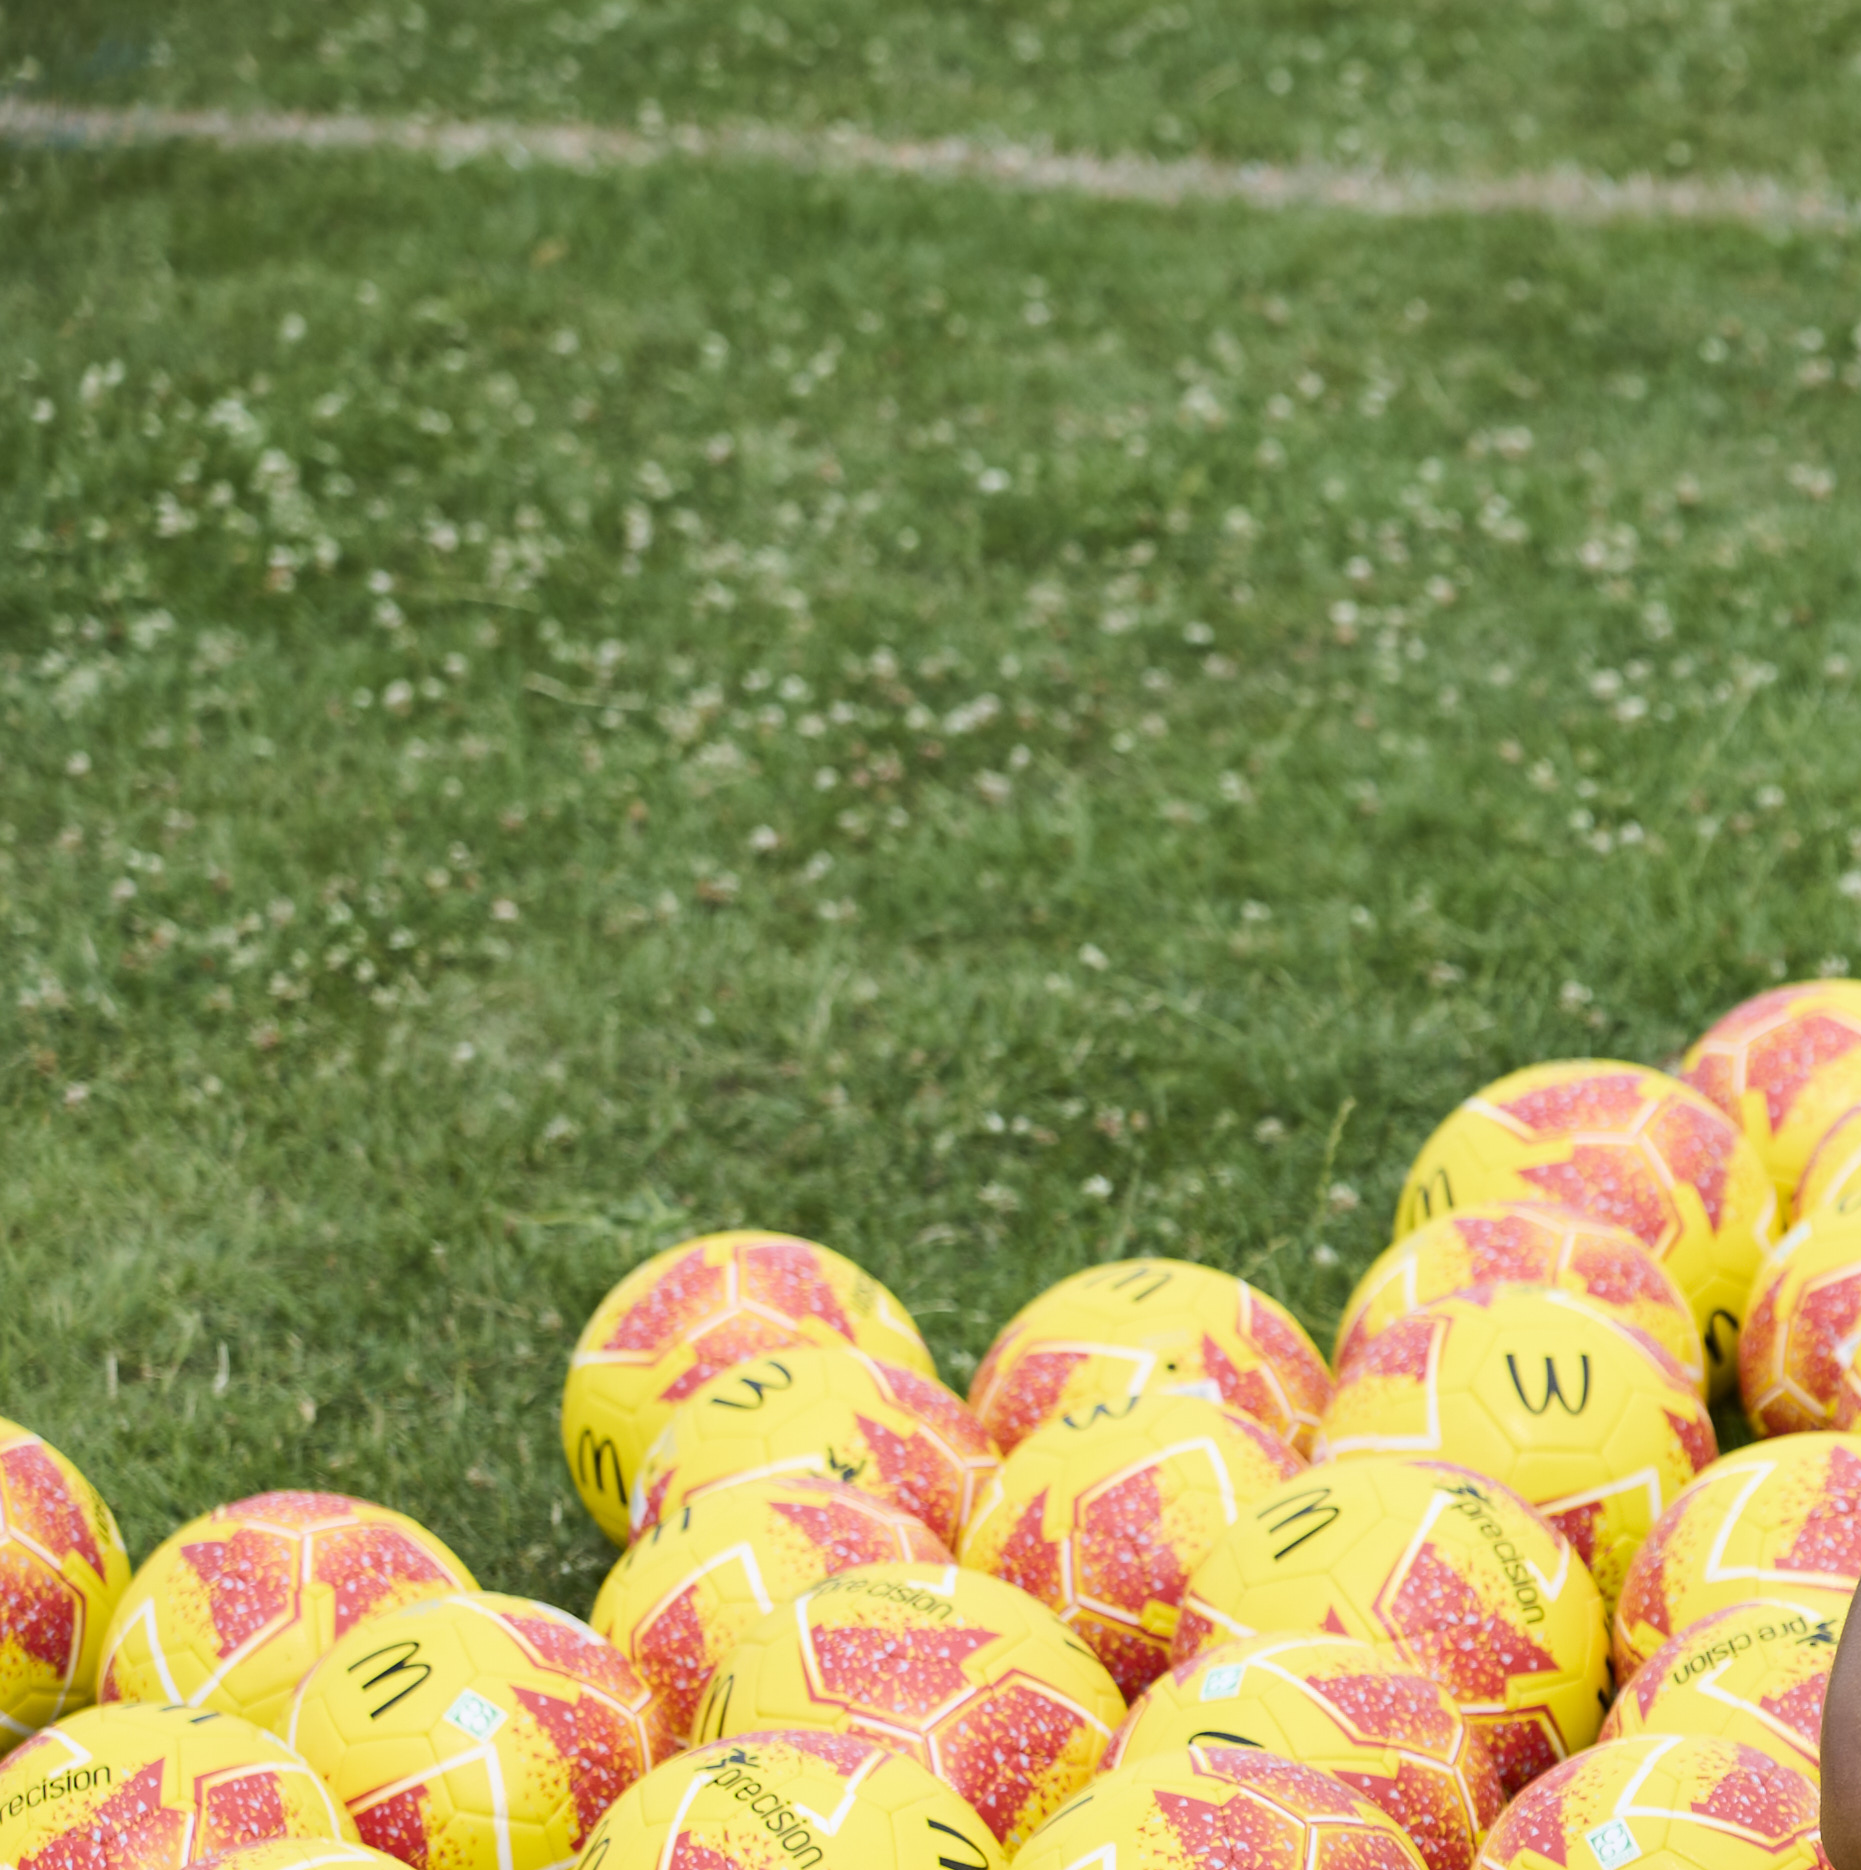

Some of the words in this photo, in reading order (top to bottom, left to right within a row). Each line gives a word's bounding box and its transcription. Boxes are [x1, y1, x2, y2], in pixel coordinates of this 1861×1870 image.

[713, 1363, 790, 1407] M
[1505, 1352, 1590, 1416] M
[577, 1427, 627, 1507] M
[1255, 1487, 1342, 1561] M
[1451, 1495, 1547, 1627] precision
[348, 1642, 431, 1719] M
[1671, 1614, 1811, 1687] precision
[713, 1766, 823, 1869] precision
